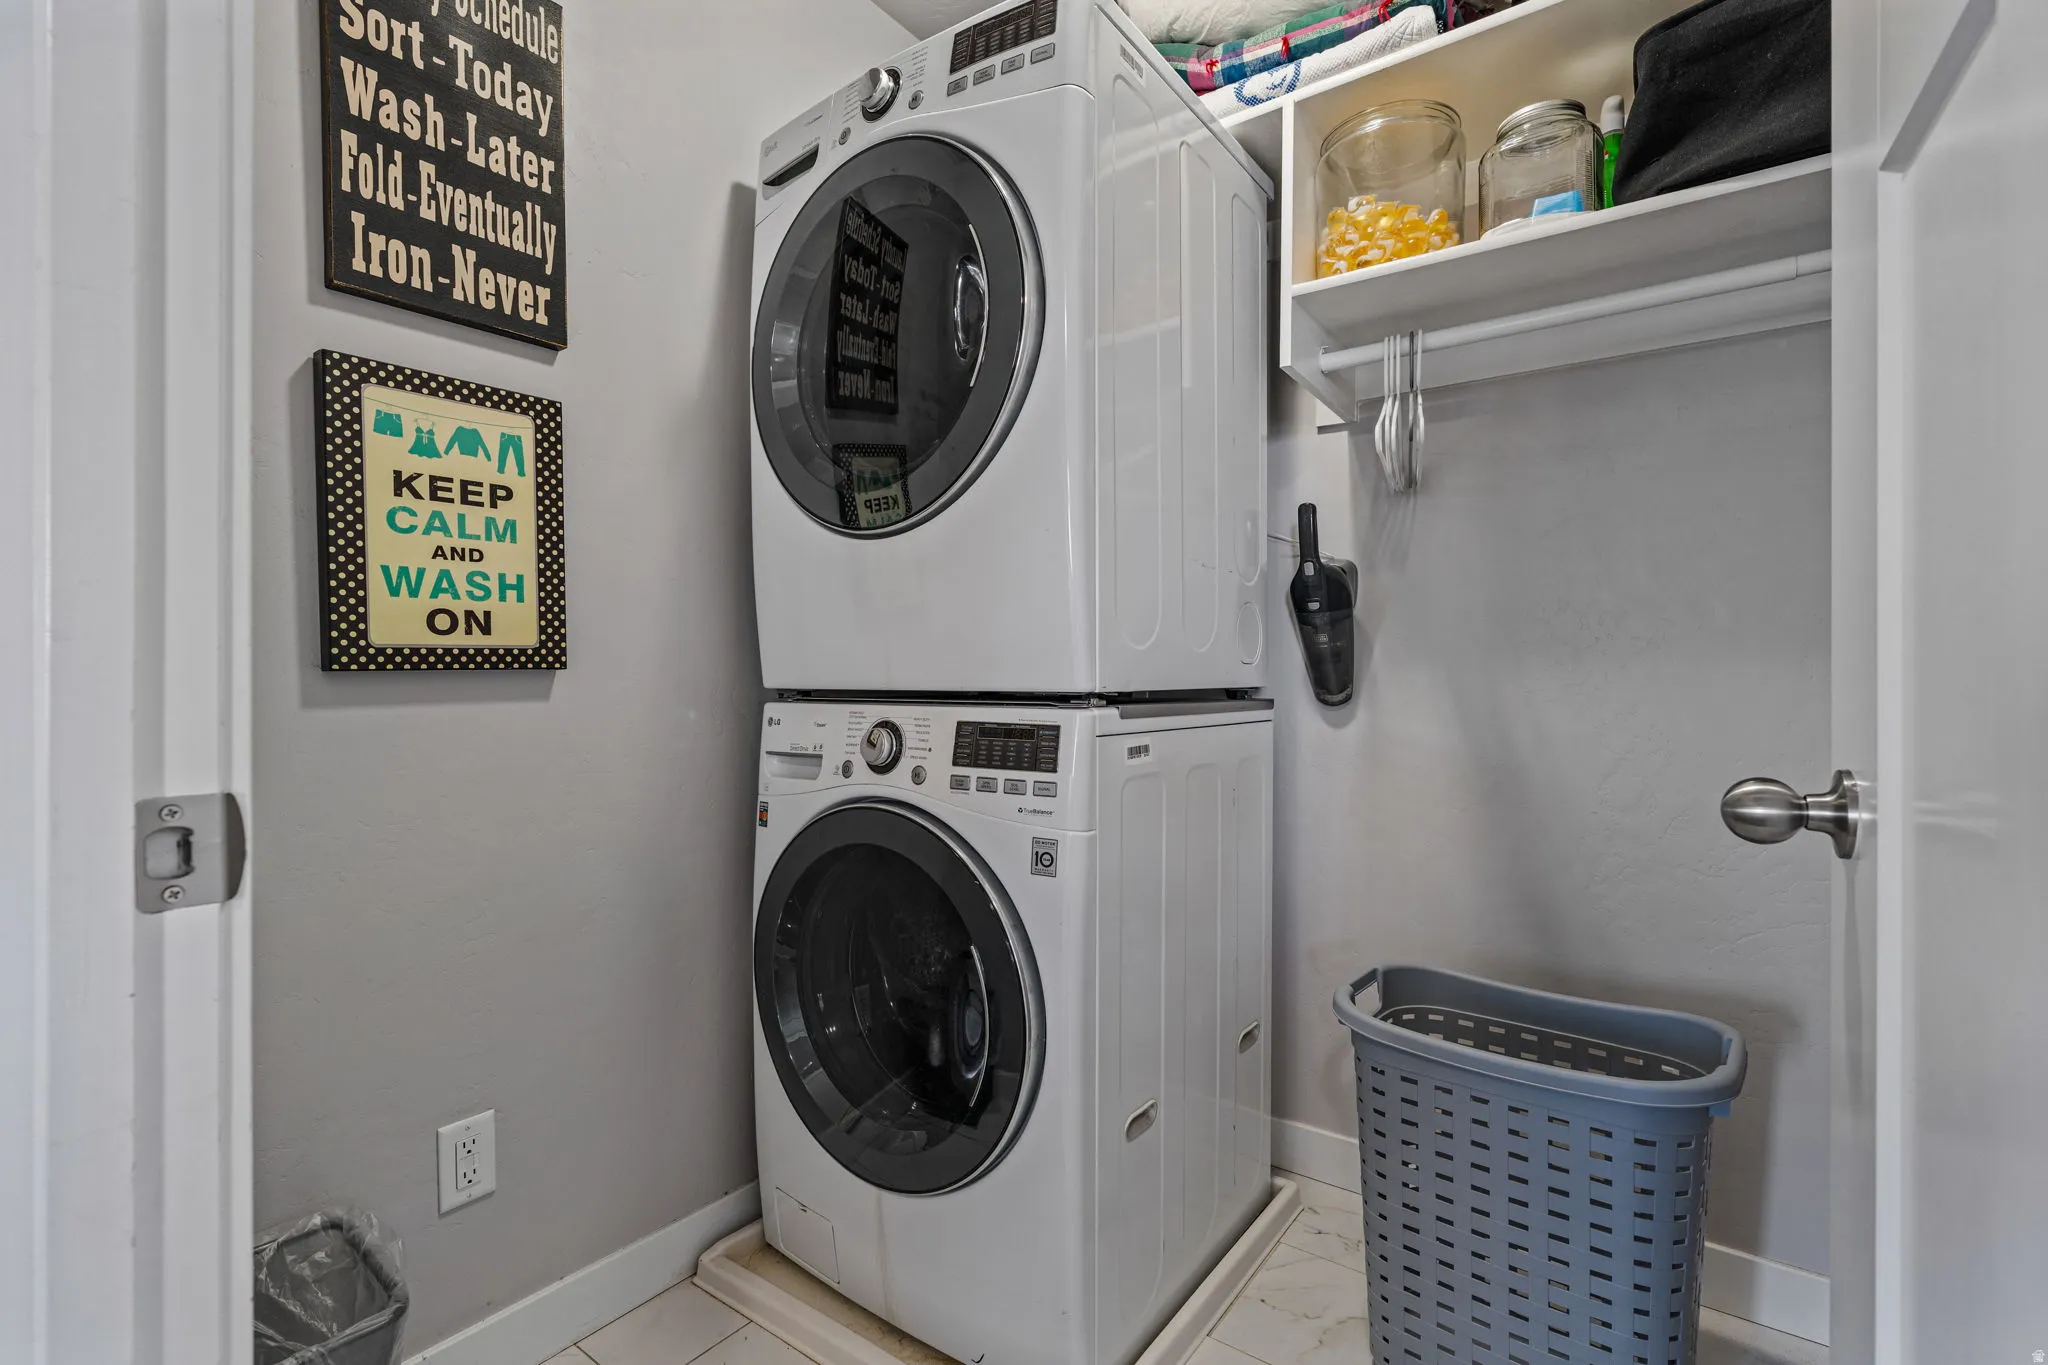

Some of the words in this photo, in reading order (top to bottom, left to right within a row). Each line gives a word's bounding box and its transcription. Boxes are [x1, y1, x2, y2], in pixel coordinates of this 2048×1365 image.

[393, 469, 514, 509] KEEP
[386, 505, 517, 544] CALM
[431, 545, 484, 562] AND
[380, 564, 525, 603] WASH
[426, 608, 492, 636] ON
[1035, 850, 1054, 868] 10
